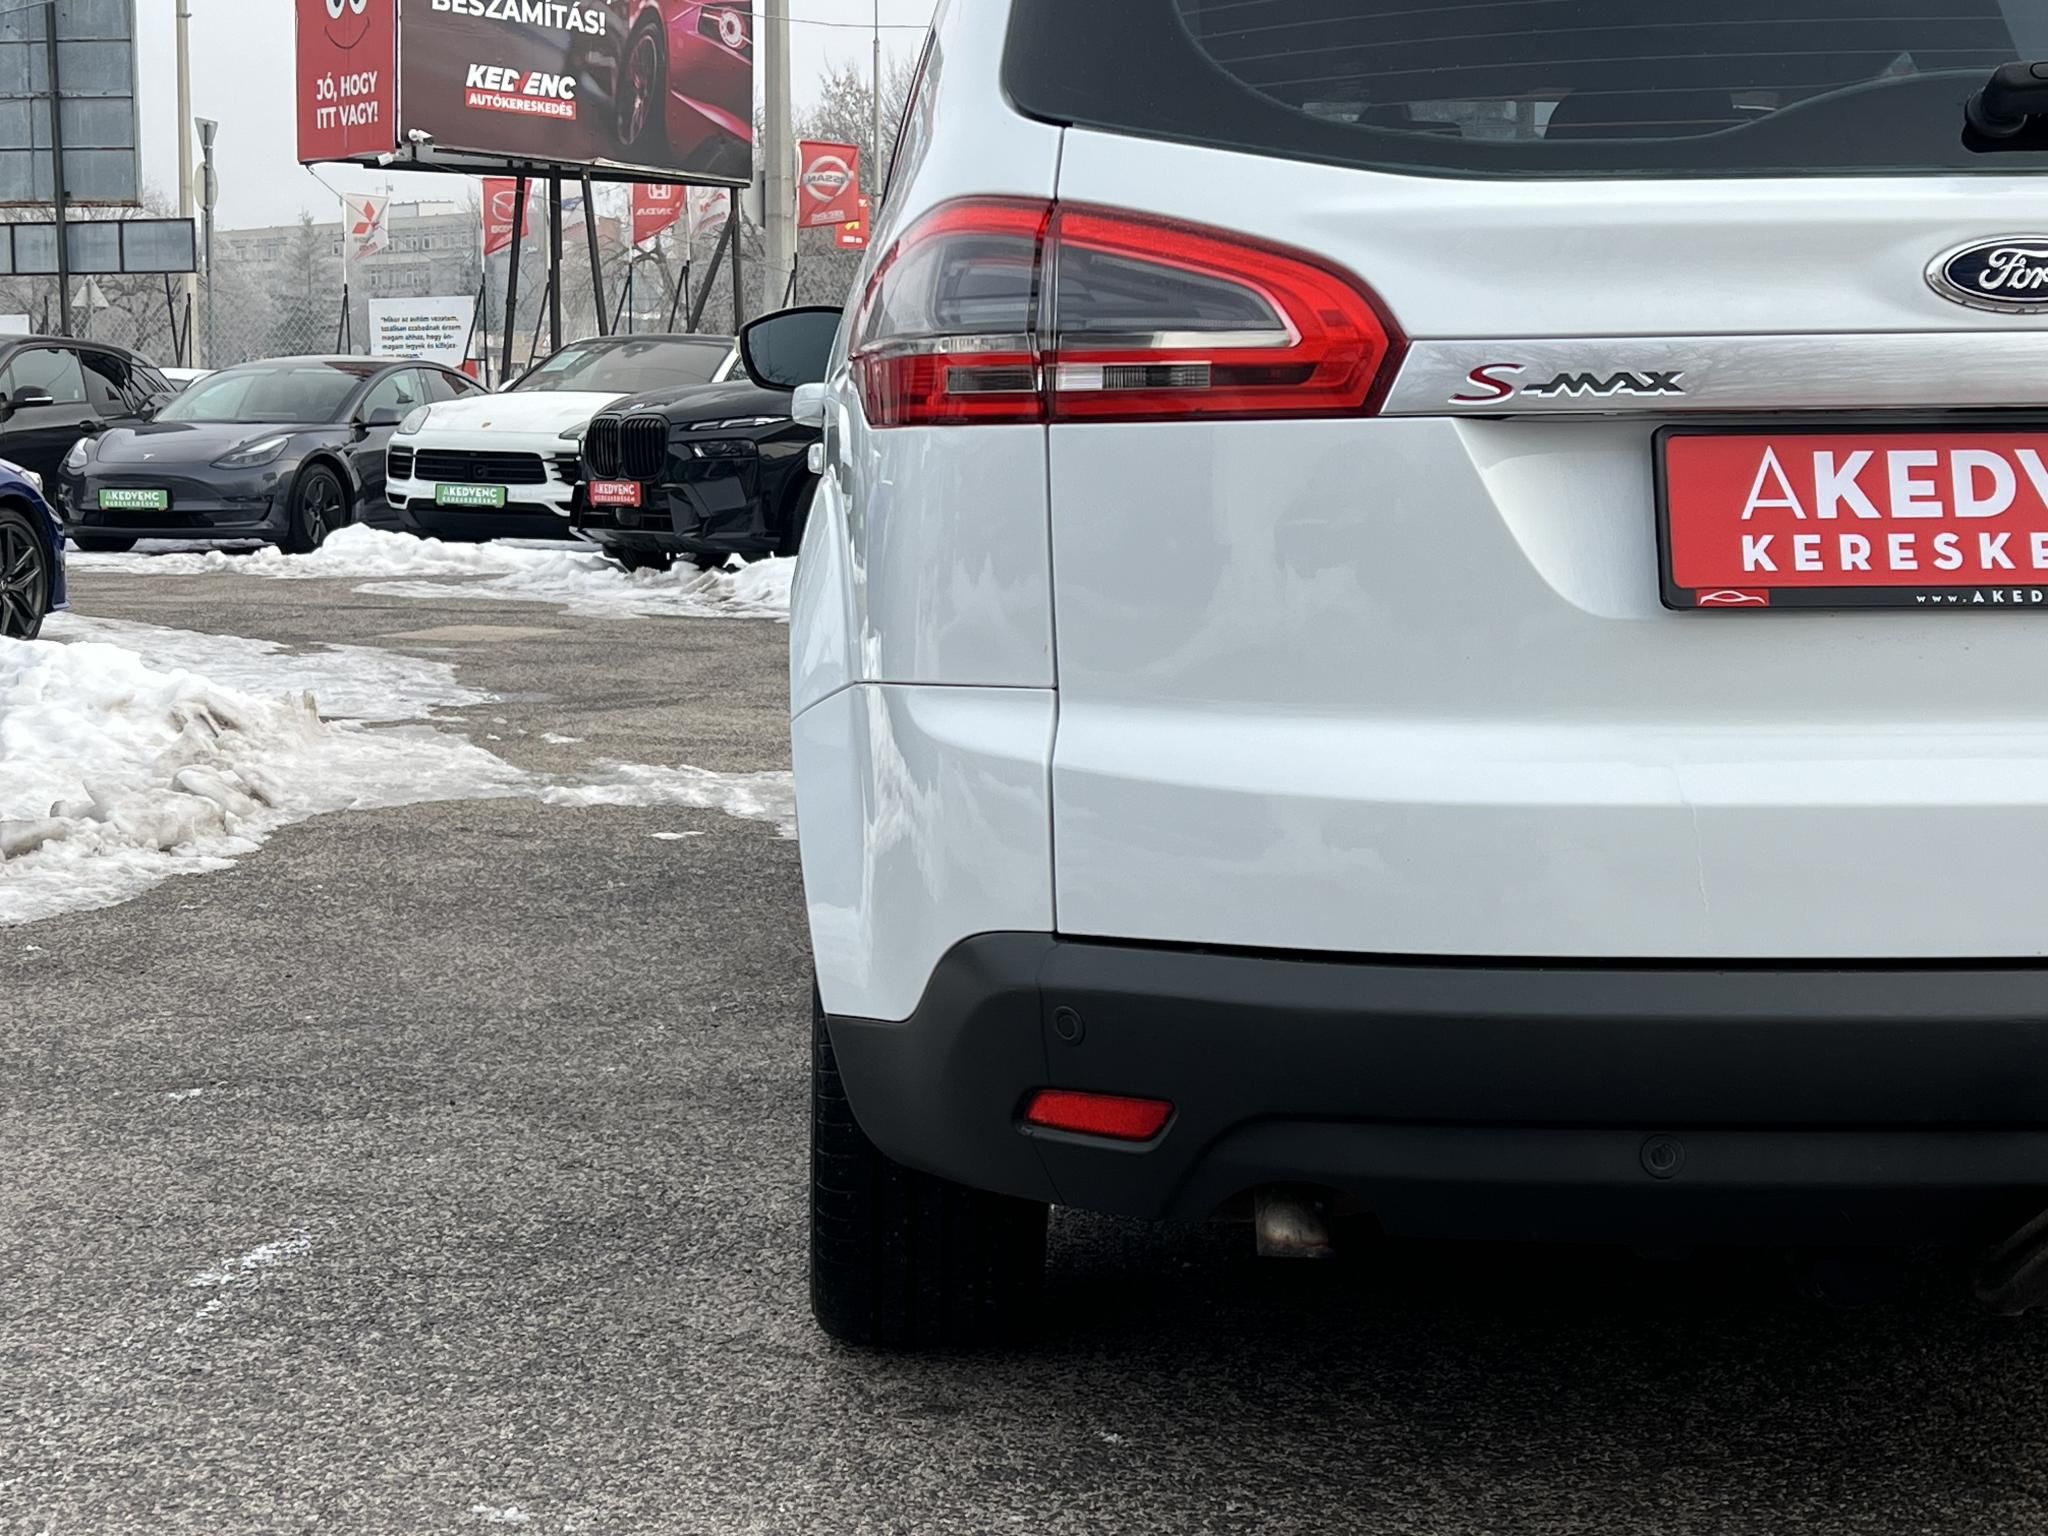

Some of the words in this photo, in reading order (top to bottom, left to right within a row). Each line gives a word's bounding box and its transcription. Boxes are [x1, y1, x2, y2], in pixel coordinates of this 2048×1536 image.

[316, 71, 337, 102] JÓ,
[341, 70, 378, 97] HOGY
[317, 106, 337, 129] ITT
[339, 101, 378, 126] VAGY!
[469, 93, 573, 116] AUTÓKERESKEDÉS
[1448, 363, 1686, 405] S-MAX
[105, 490, 159, 500] AKEDVENC
[443, 486, 497, 497] AKEDVENC
[1742, 531, 2048, 571] KERESKE
